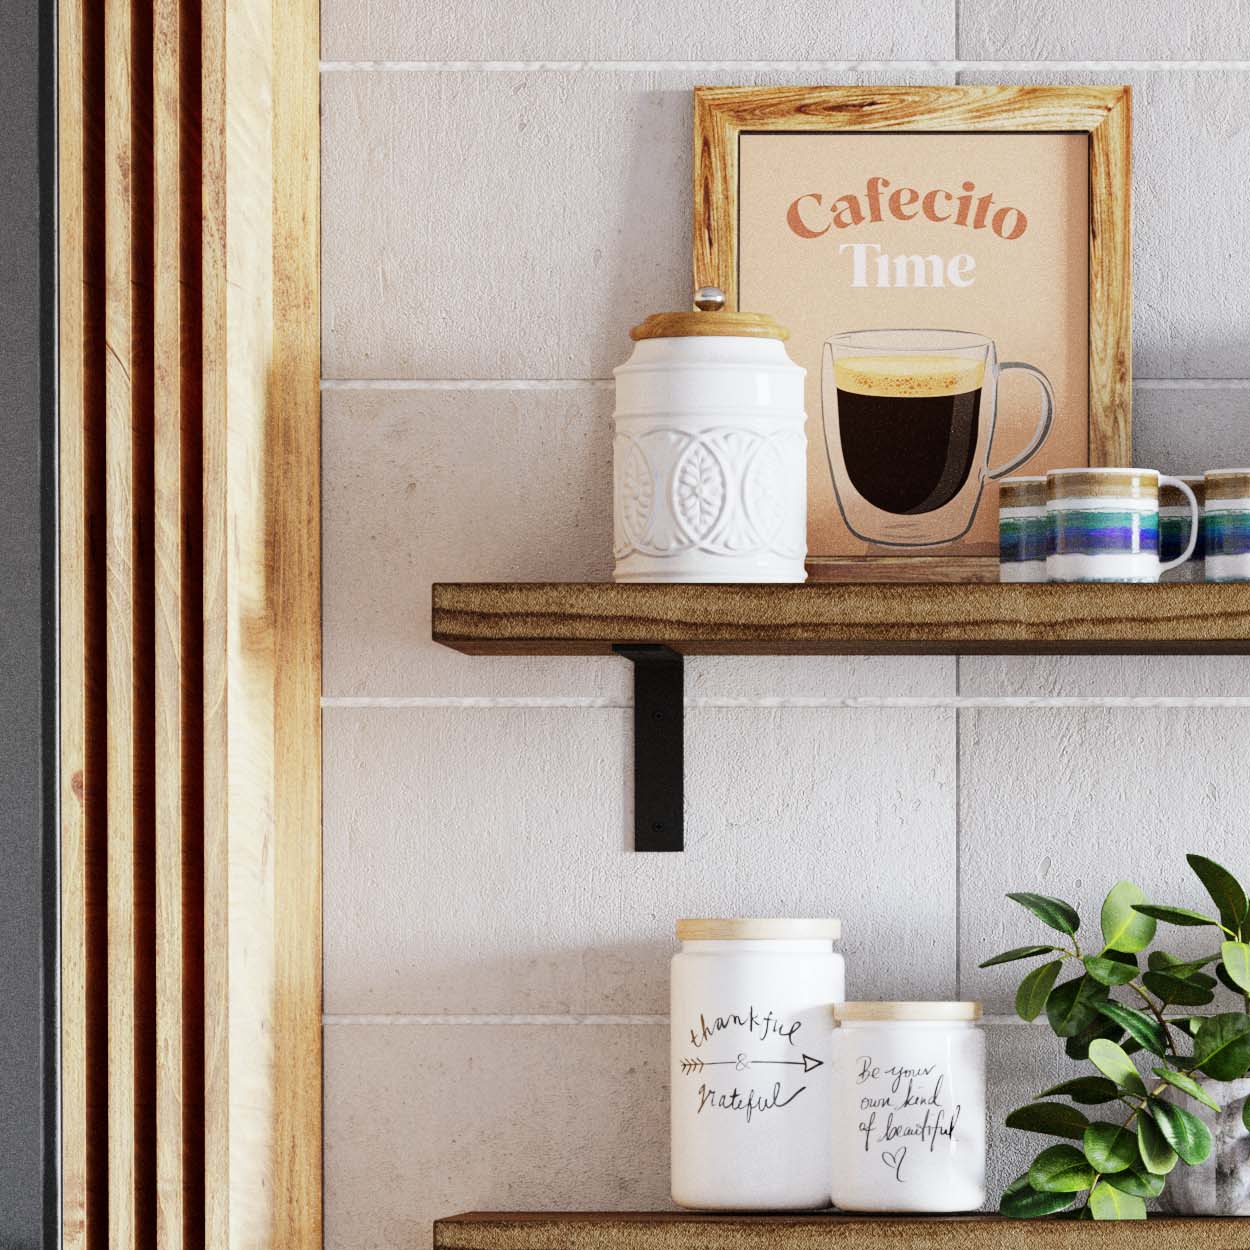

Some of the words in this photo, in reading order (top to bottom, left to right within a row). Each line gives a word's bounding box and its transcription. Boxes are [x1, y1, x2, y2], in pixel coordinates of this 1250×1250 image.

[786, 176, 1028, 240] Cafecito
[839, 243, 977, 288] Time
[735, 1053, 751, 1071] &
[855, 1055, 880, 1085] Be
[884, 1064, 936, 1094] your
[860, 1097, 892, 1110] own
[895, 1074, 944, 1110] kind
[858, 1112, 876, 1151] of
[877, 1105, 961, 1152] beautiful
